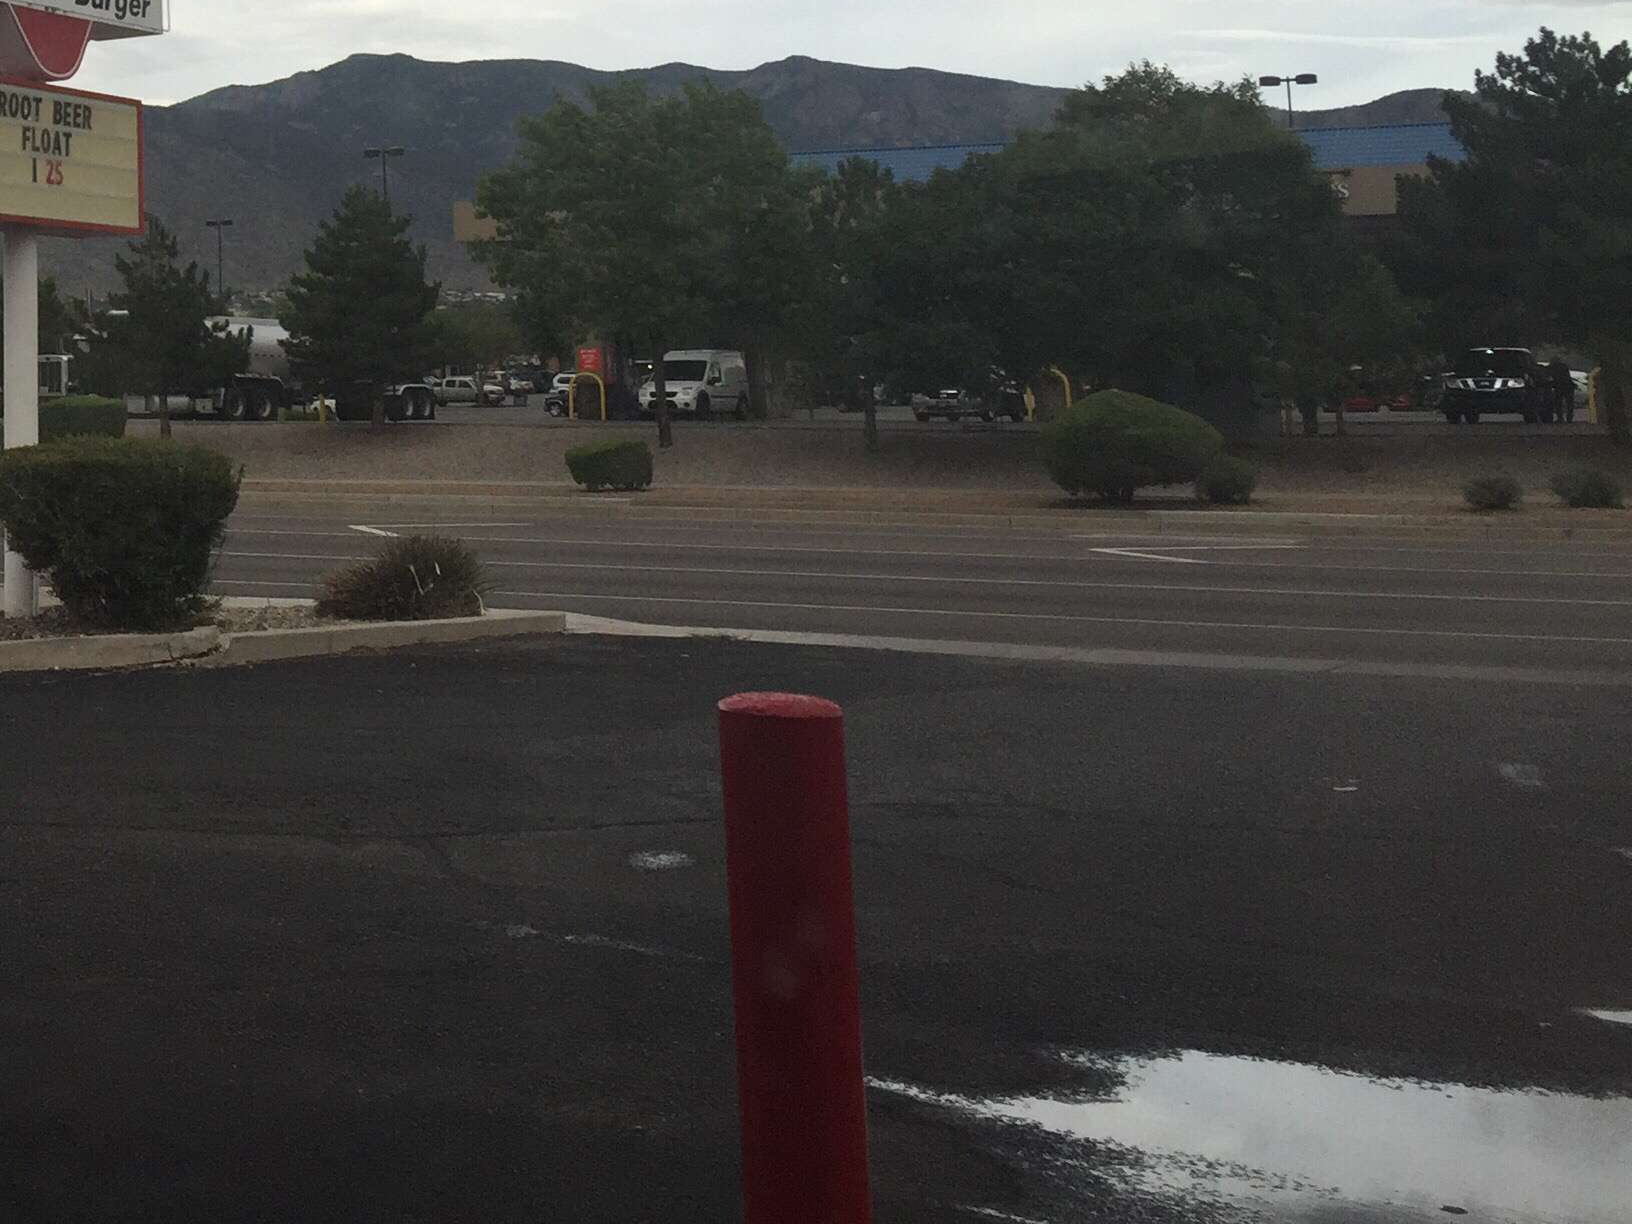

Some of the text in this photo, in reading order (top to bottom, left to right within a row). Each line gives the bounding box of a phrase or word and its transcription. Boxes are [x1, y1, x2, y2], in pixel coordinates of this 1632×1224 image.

[52, 101, 93, 131] BEER
[21, 126, 73, 157] FLOAT
[45, 159, 64, 185] 25
